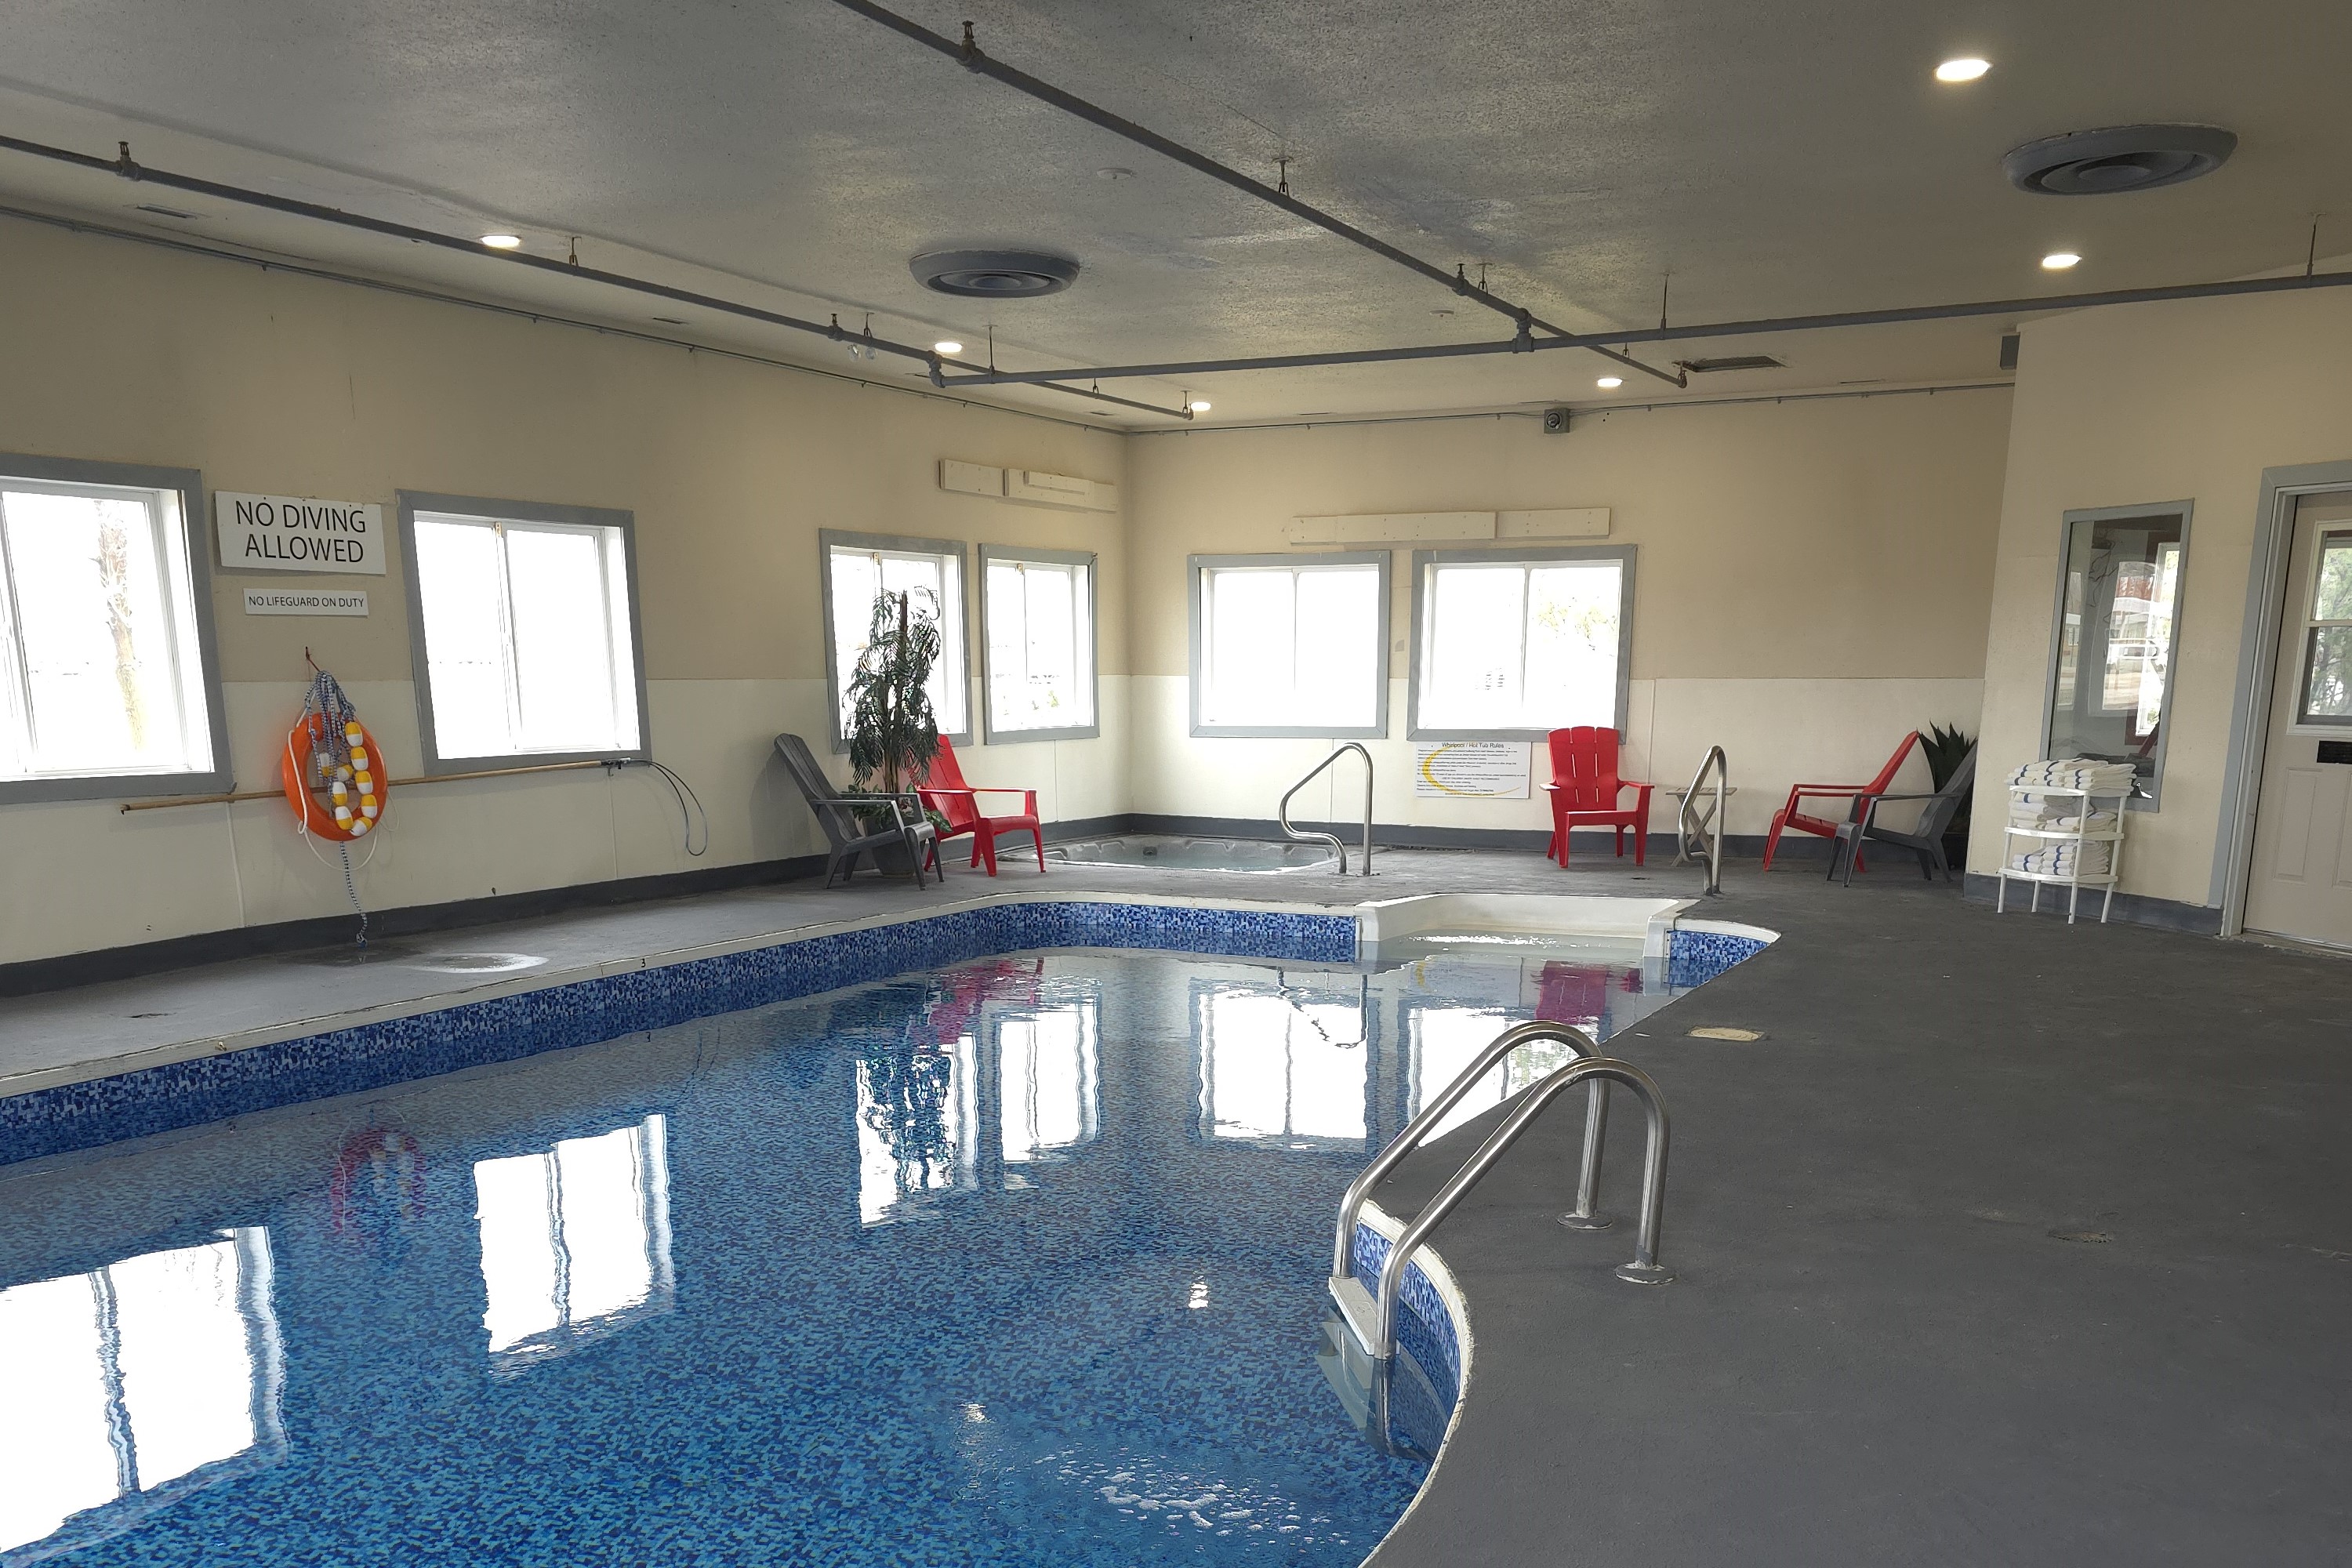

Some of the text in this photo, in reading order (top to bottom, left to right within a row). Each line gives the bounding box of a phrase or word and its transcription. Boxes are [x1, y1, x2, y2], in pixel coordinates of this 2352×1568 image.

[236, 500, 366, 533] NO DIVING
[245, 534, 364, 563] ALLOWED
[249, 596, 365, 608] NO LIFEGUARD ON DUTY
[641, 958, 646, 967] 3
